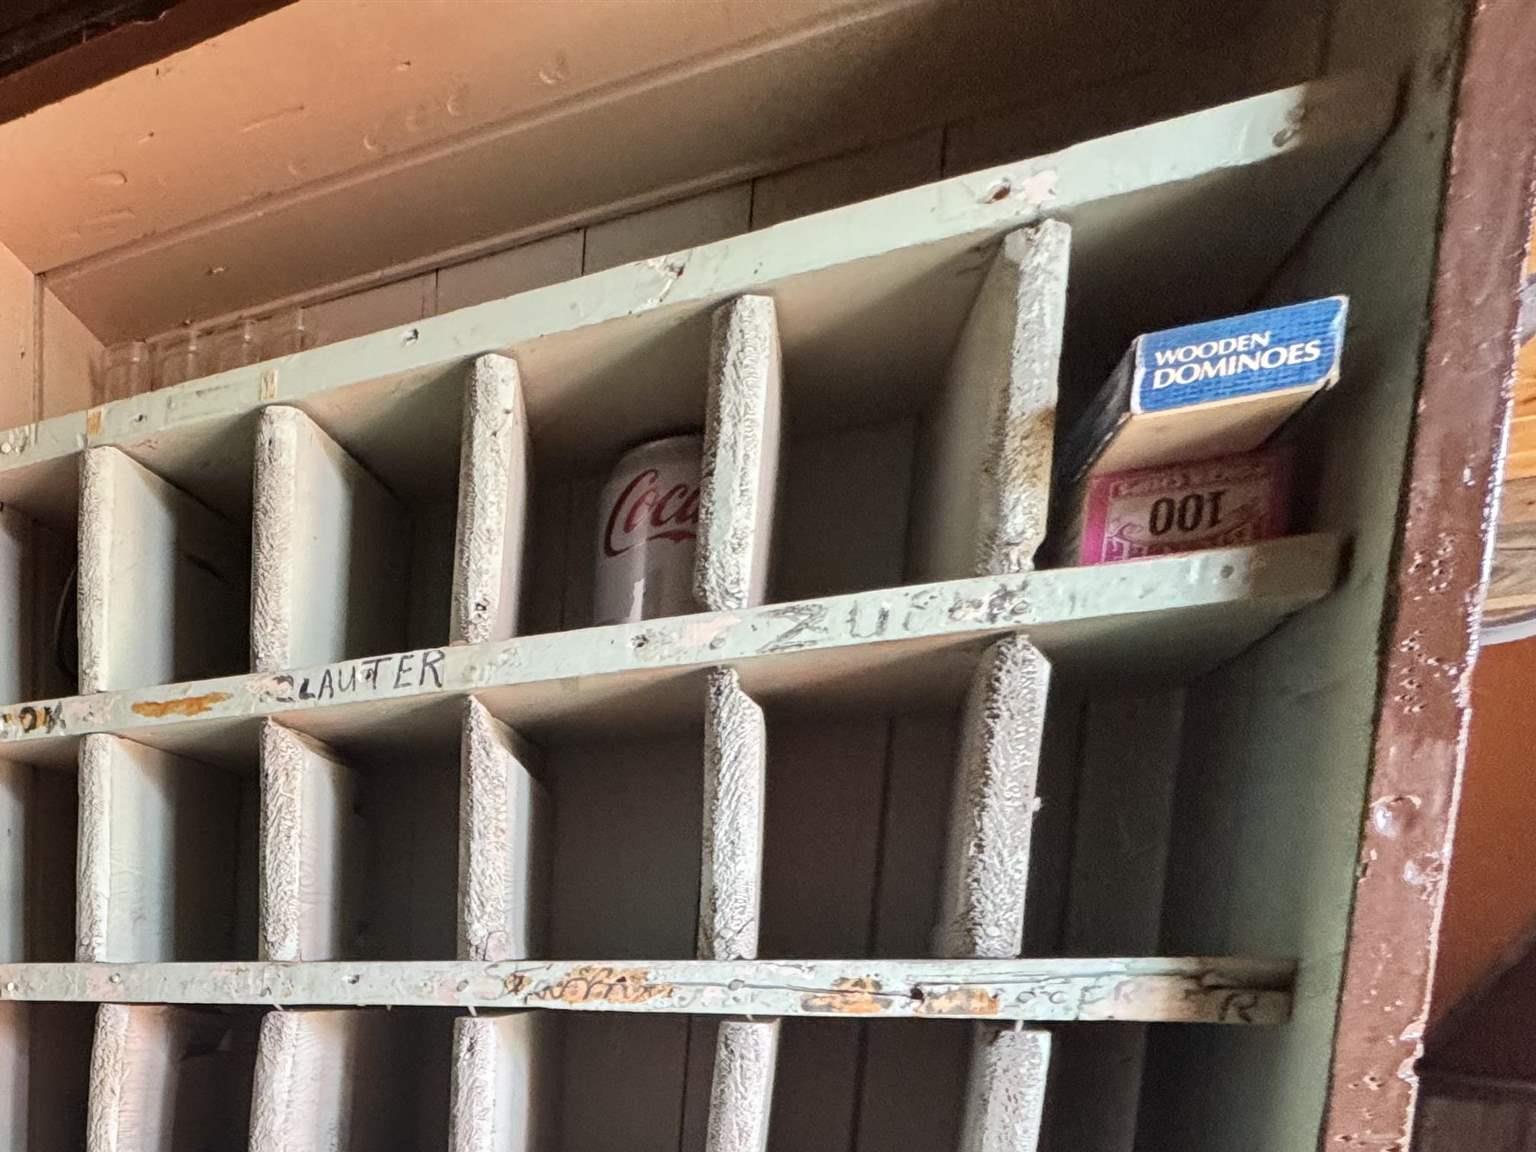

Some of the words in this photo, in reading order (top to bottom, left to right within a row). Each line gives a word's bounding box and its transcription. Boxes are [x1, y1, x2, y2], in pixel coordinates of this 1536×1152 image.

[1152, 340, 1322, 390] DOMINOES
[1154, 330, 1272, 366] WOODEN
[1148, 490, 1228, 538] 100
